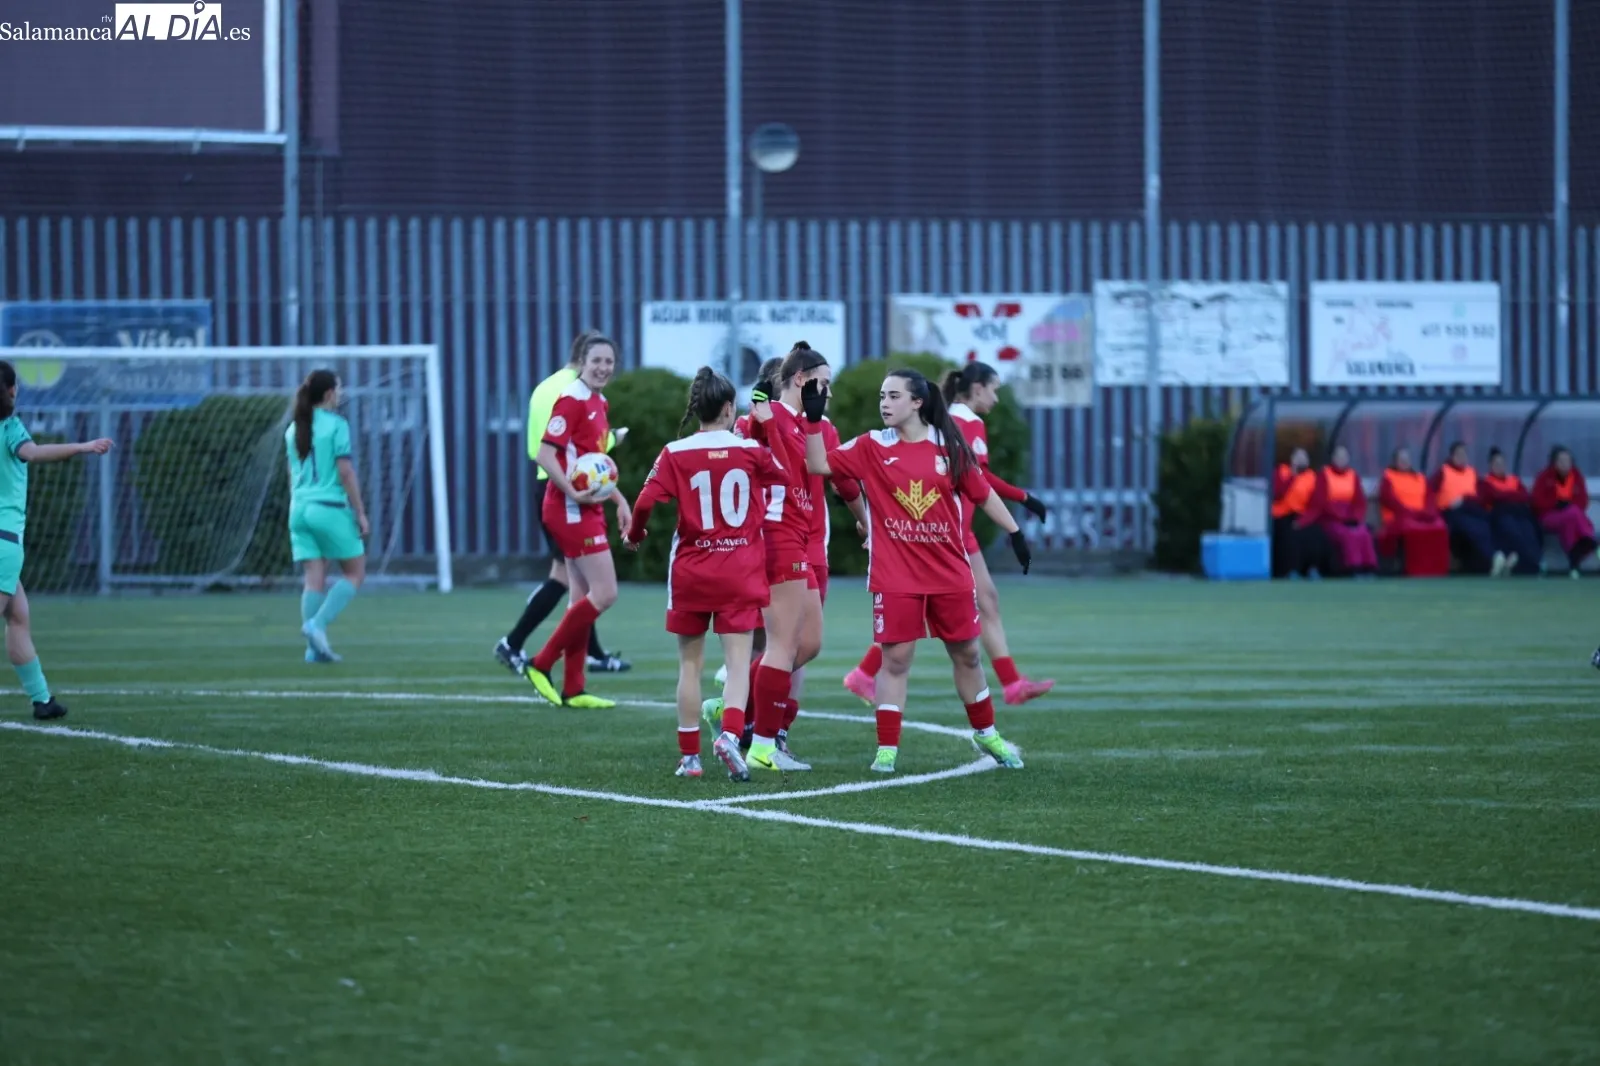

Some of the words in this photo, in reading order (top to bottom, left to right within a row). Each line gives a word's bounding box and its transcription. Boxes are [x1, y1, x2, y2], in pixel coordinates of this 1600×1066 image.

[698, 306, 762, 324] MINEAL
[689, 468, 750, 531] 10
[884, 517, 913, 532] CAJA
